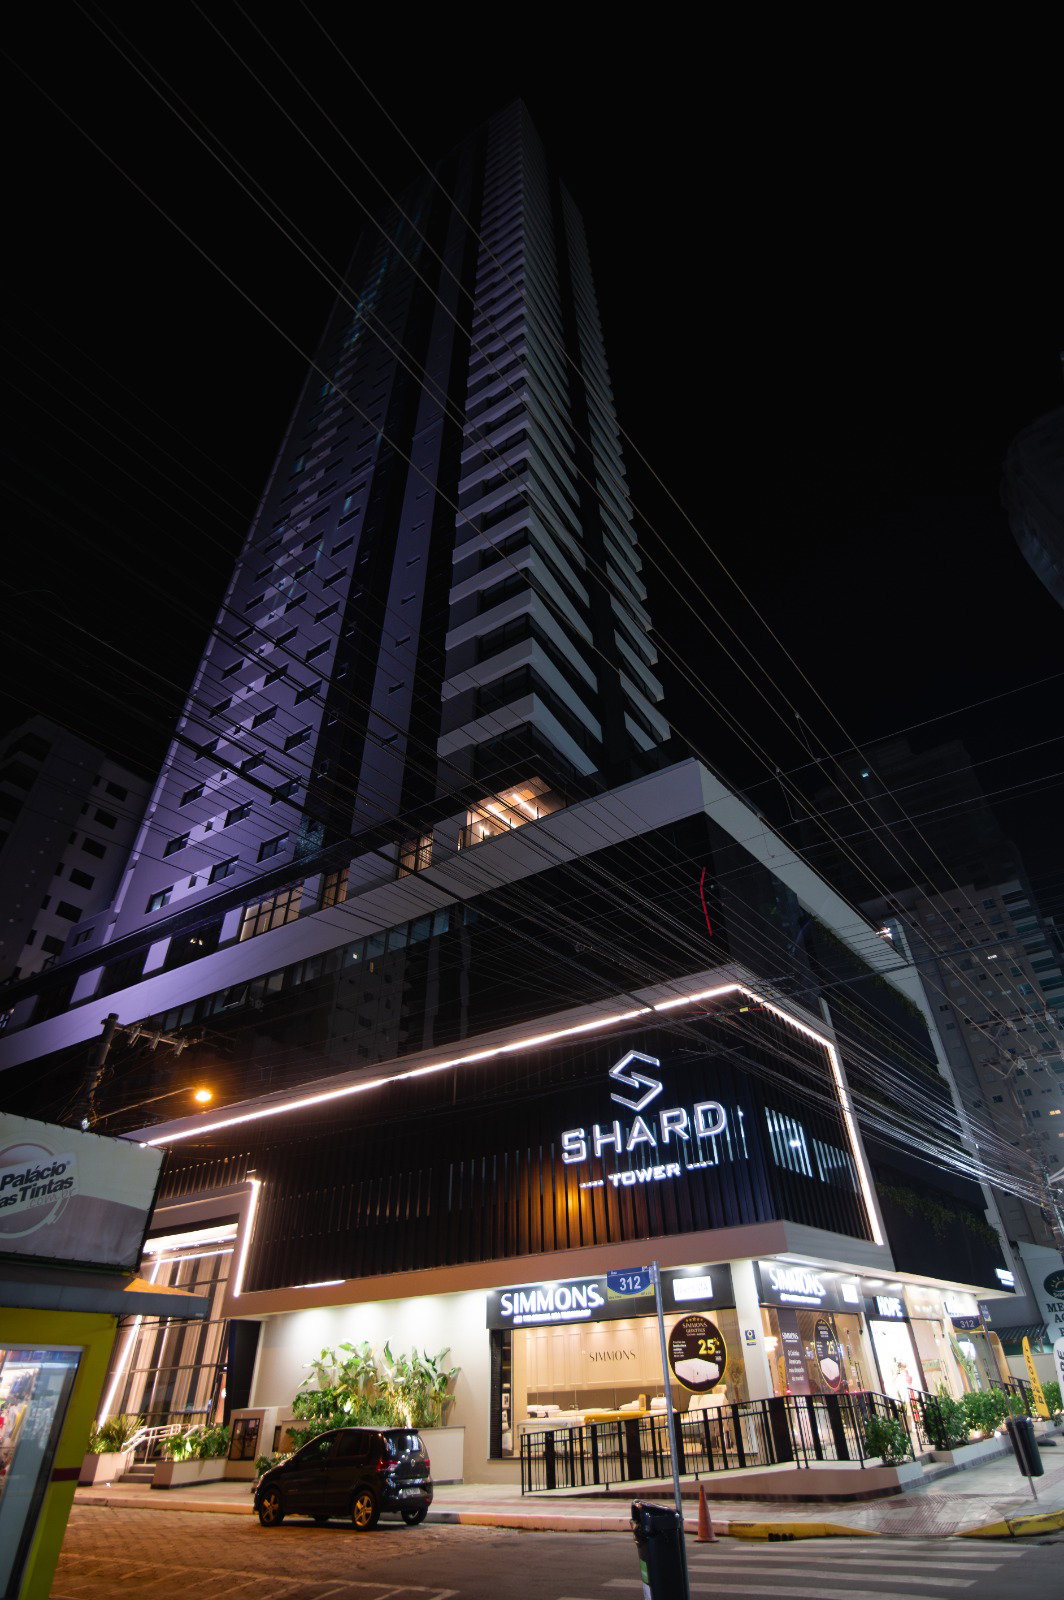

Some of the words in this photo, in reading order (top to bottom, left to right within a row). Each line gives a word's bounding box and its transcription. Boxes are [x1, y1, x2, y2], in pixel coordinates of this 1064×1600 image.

[562, 1101, 727, 1164] SHARD
[0, 1161, 67, 1191] Palácio
[608, 1162, 681, 1187] TOWER
[19, 1177, 74, 1202] Tintas
[619, 1275, 641, 1291] 312
[768, 1267, 827, 1297] SIMMONS
[500, 1284, 602, 1316] SIMMONS
[960, 1319, 975, 1329] 312
[589, 1349, 636, 1362] SIMMONS
